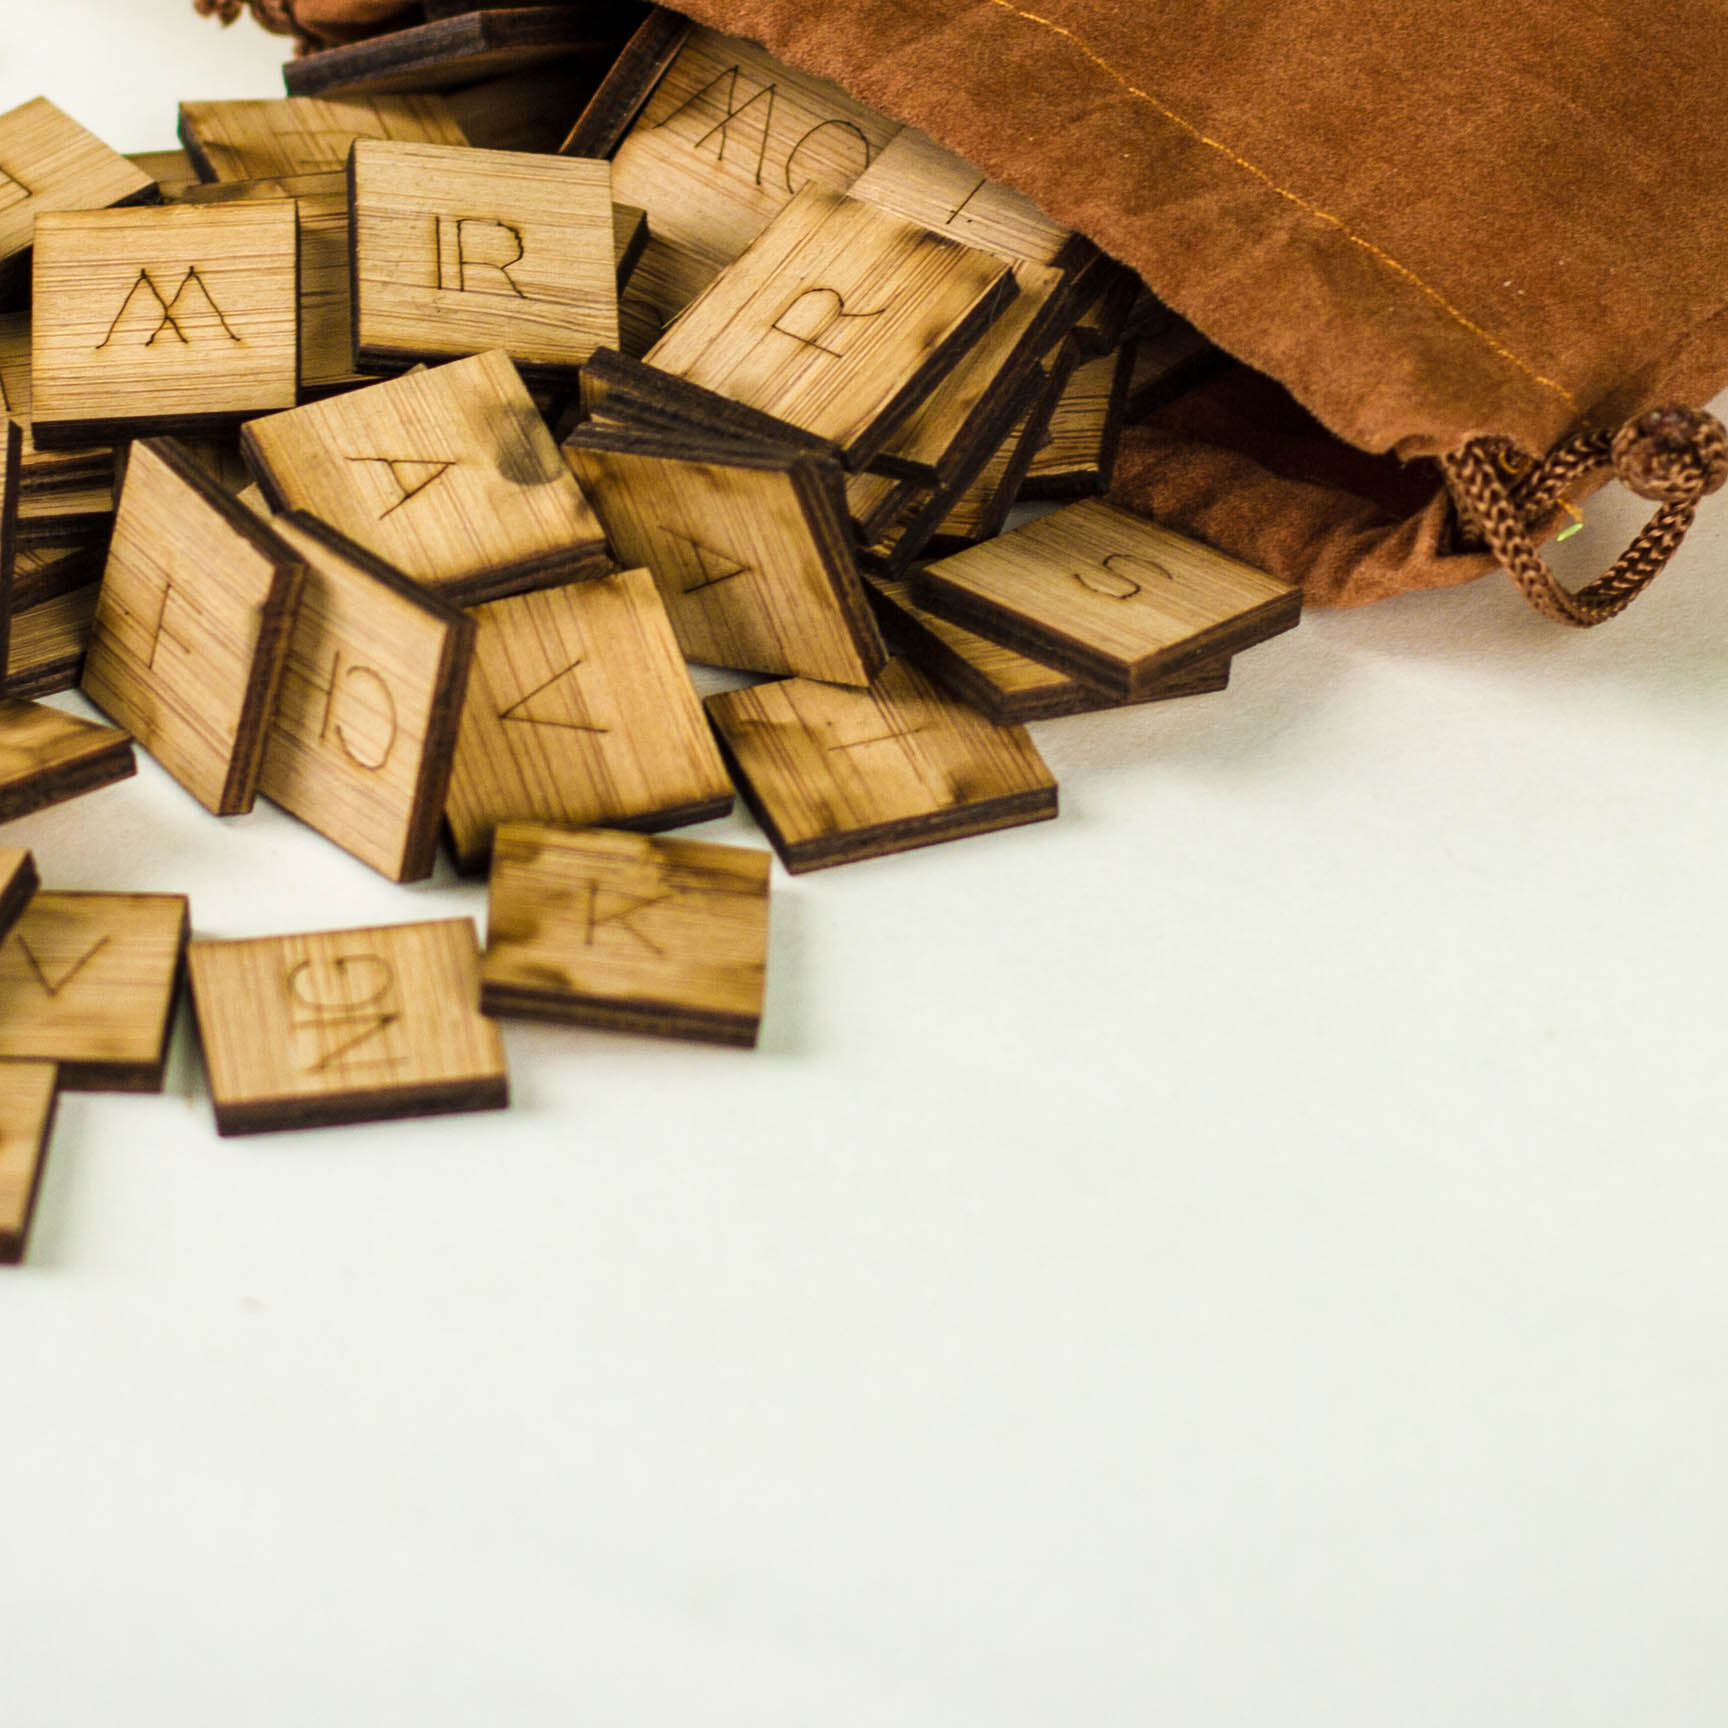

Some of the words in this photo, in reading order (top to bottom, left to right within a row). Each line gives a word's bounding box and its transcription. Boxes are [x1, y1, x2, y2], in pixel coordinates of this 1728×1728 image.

[435, 215, 529, 299] IR
[772, 287, 886, 359] R
[344, 455, 458, 521] A
[1074, 553, 1173, 599] S
[584, 878, 674, 956] K
